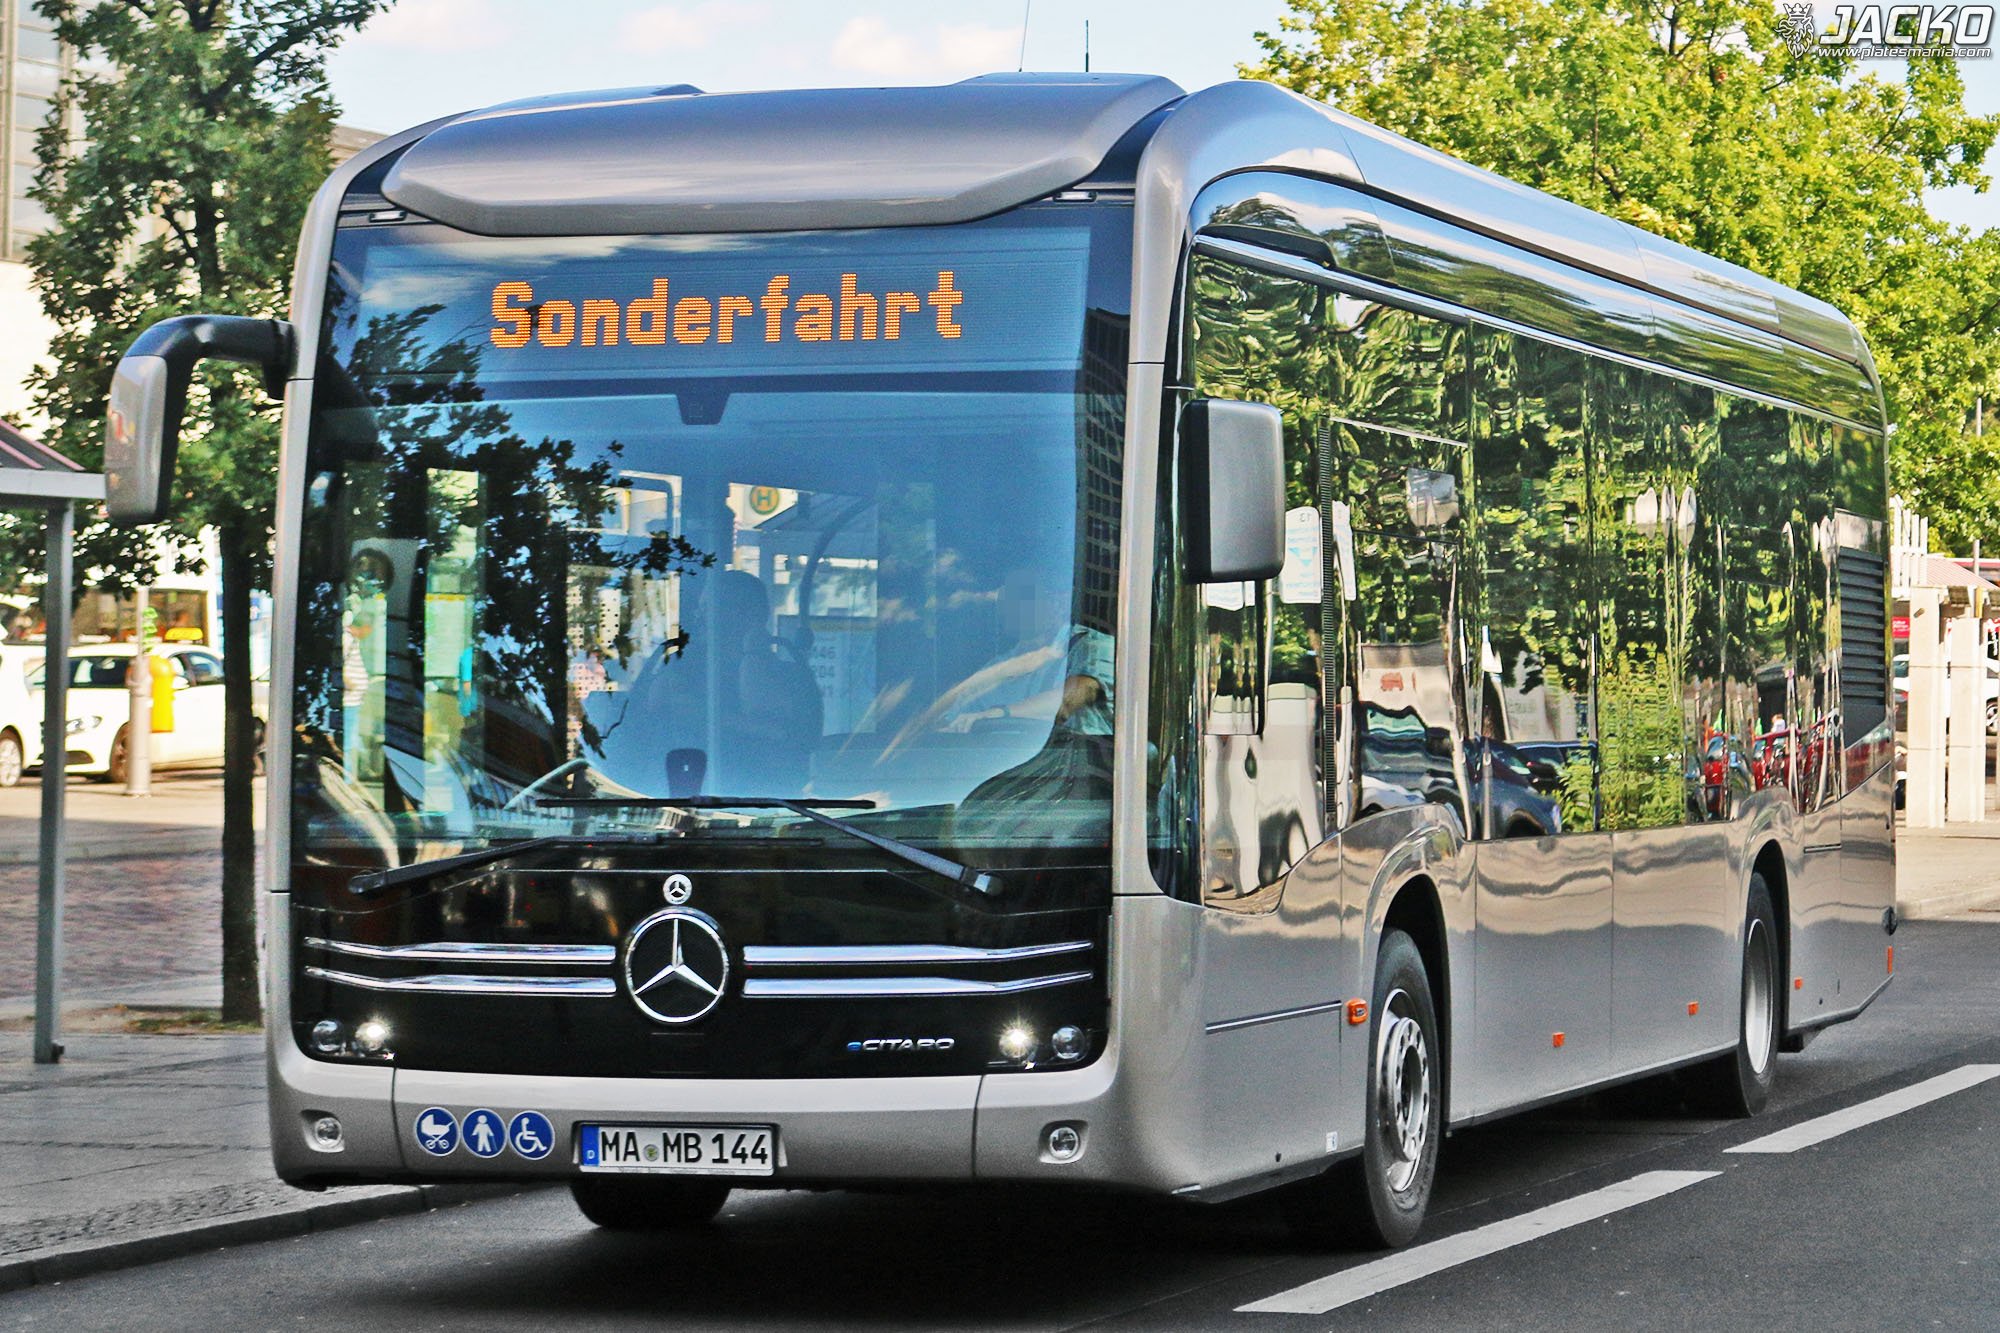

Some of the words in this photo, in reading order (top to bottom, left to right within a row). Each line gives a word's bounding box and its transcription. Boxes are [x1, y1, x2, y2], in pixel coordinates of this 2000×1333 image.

[490, 270, 964, 349] Sonderfahrt
[757, 489, 771, 507] H
[601, 1131, 640, 1162] MA
[662, 1132, 701, 1163] MB
[711, 1133, 768, 1165] 144
